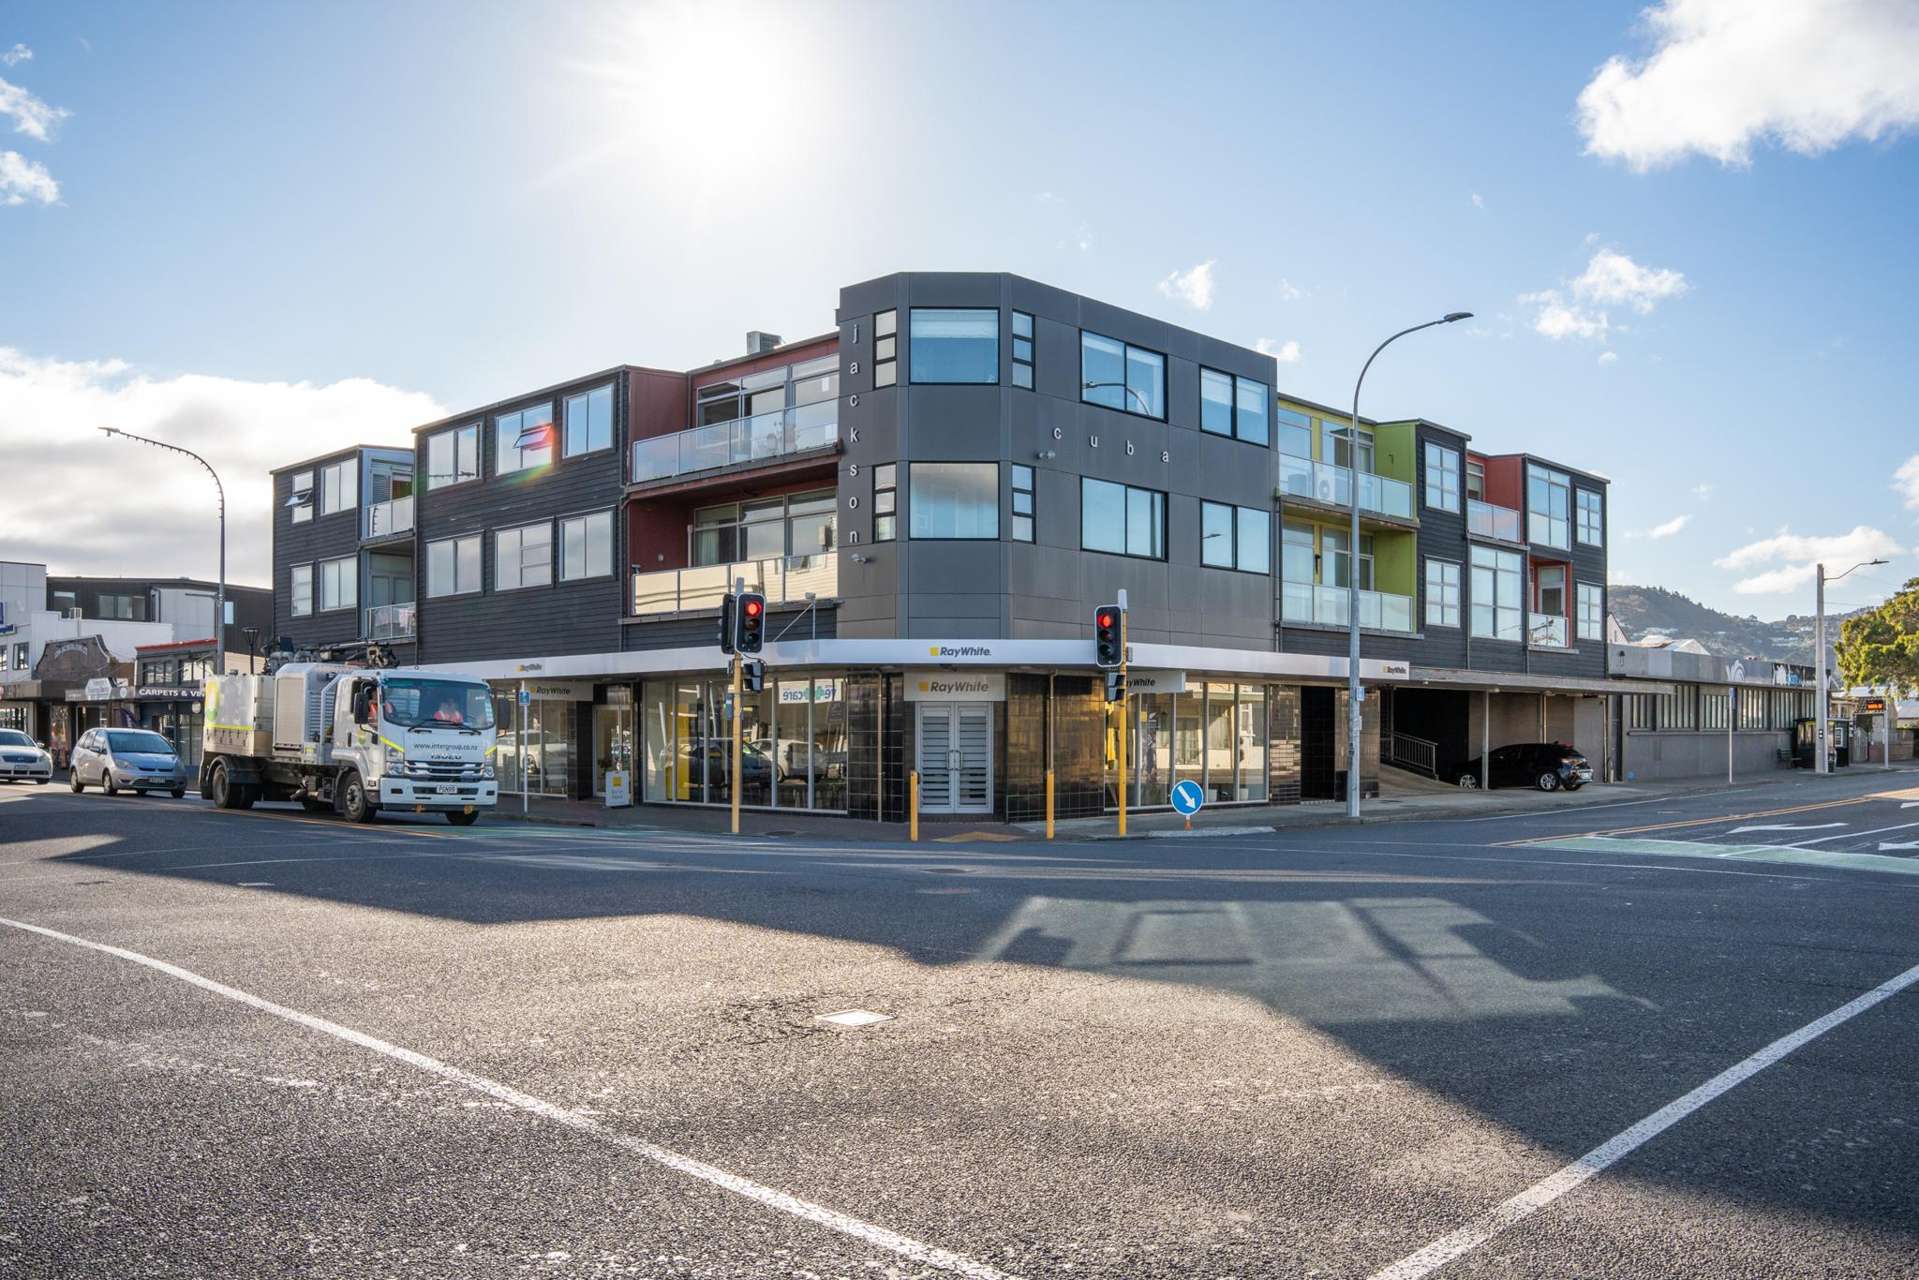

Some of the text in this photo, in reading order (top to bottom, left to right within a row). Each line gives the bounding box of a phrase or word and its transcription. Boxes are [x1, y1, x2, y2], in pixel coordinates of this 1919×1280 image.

[849, 323, 860, 544] jackson
[1053, 427, 1169, 463] cuba
[138, 687, 178, 697] CARPETS
[181, 689, 188, 697] &
[930, 681, 989, 694] RayWhite
